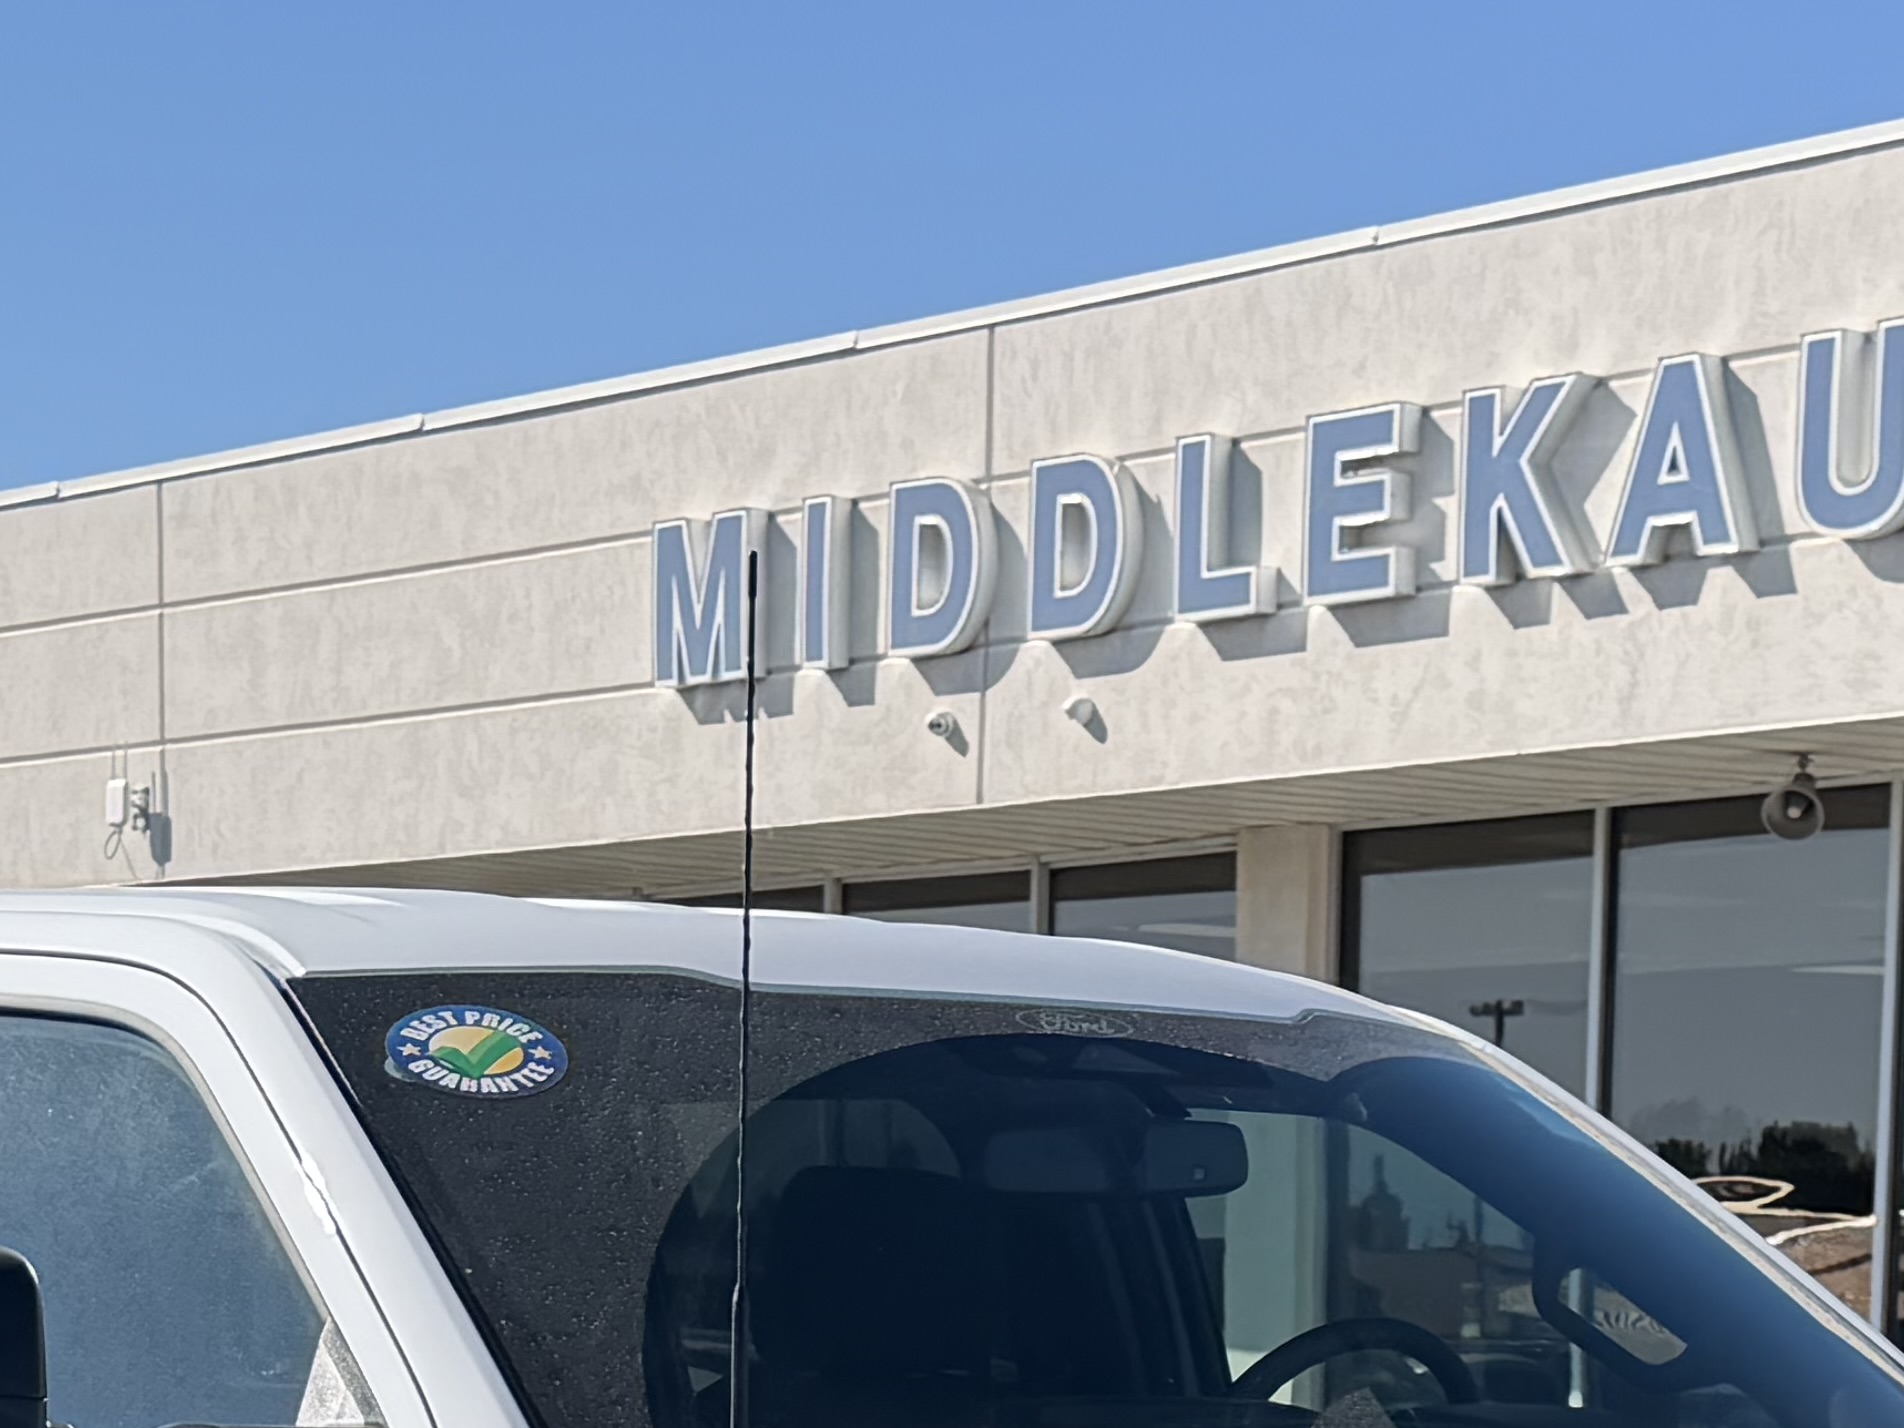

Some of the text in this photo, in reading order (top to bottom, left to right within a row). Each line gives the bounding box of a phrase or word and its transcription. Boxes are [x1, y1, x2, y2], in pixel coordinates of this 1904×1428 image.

[400, 1010, 544, 1044] BEST PRICE
[407, 1059, 555, 1094] GUARANTEE
